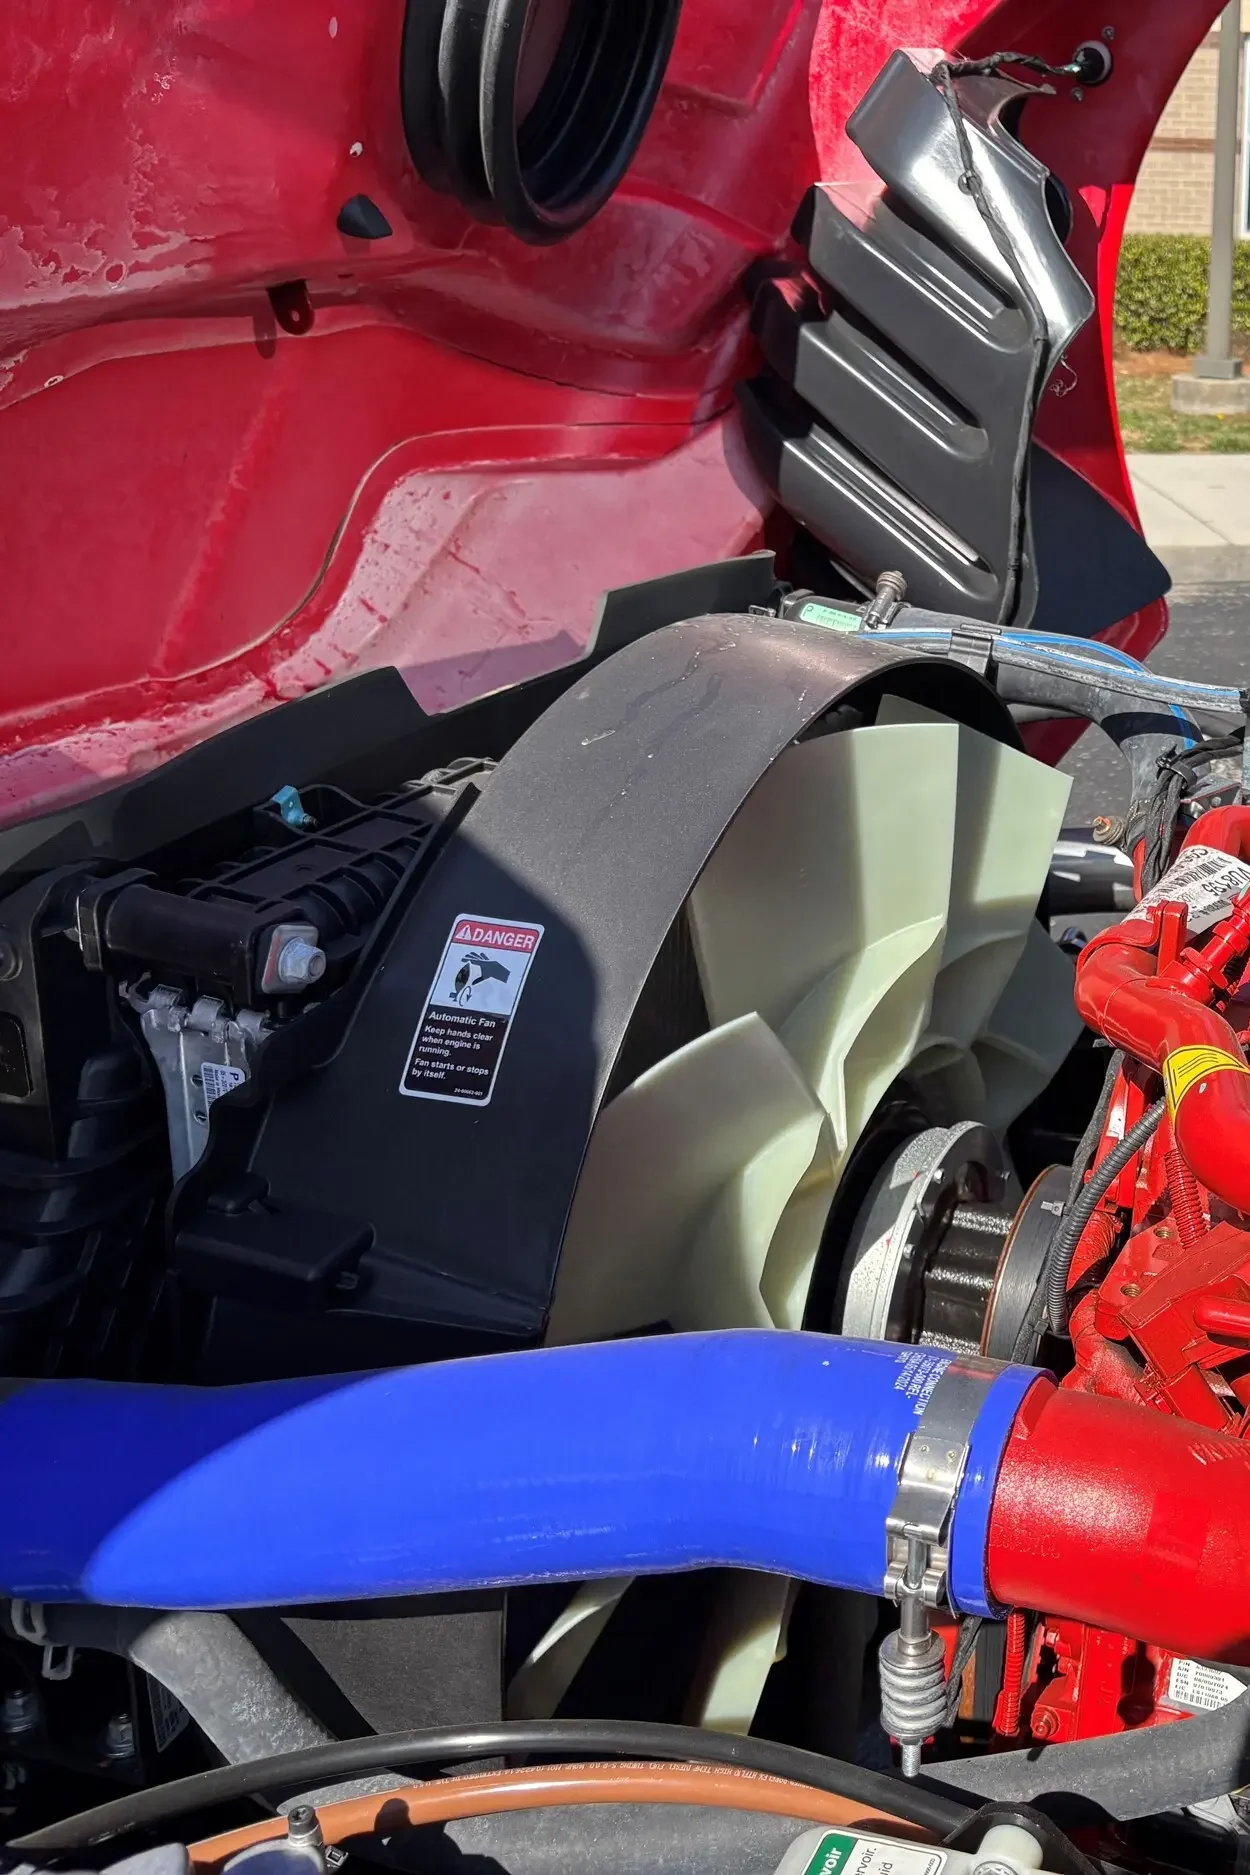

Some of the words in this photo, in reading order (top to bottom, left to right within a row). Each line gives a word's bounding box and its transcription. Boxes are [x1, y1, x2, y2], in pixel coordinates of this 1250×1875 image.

[472, 928, 535, 949] DANGER
[428, 1011, 476, 1026] Automatic
[479, 1016, 496, 1028] Fan
[424, 1025, 446, 1036] Keep
[446, 1028, 472, 1039] hands
[472, 1031, 494, 1042] clear
[418, 1045, 452, 1057] running.
[422, 1035, 442, 1045] when
[444, 1038, 472, 1050] engine
[472, 1042, 480, 1050] is
[412, 1068, 423, 1078] by
[424, 1069, 446, 1080] itself.
[414, 1058, 430, 1068] Fan
[430, 1060, 455, 1072] starts
[456, 1064, 466, 1072] or
[466, 1064, 489, 1077] stops
[912, 1374, 940, 1416] CONNECTION
[669, 1764, 692, 1772] DIESEL
